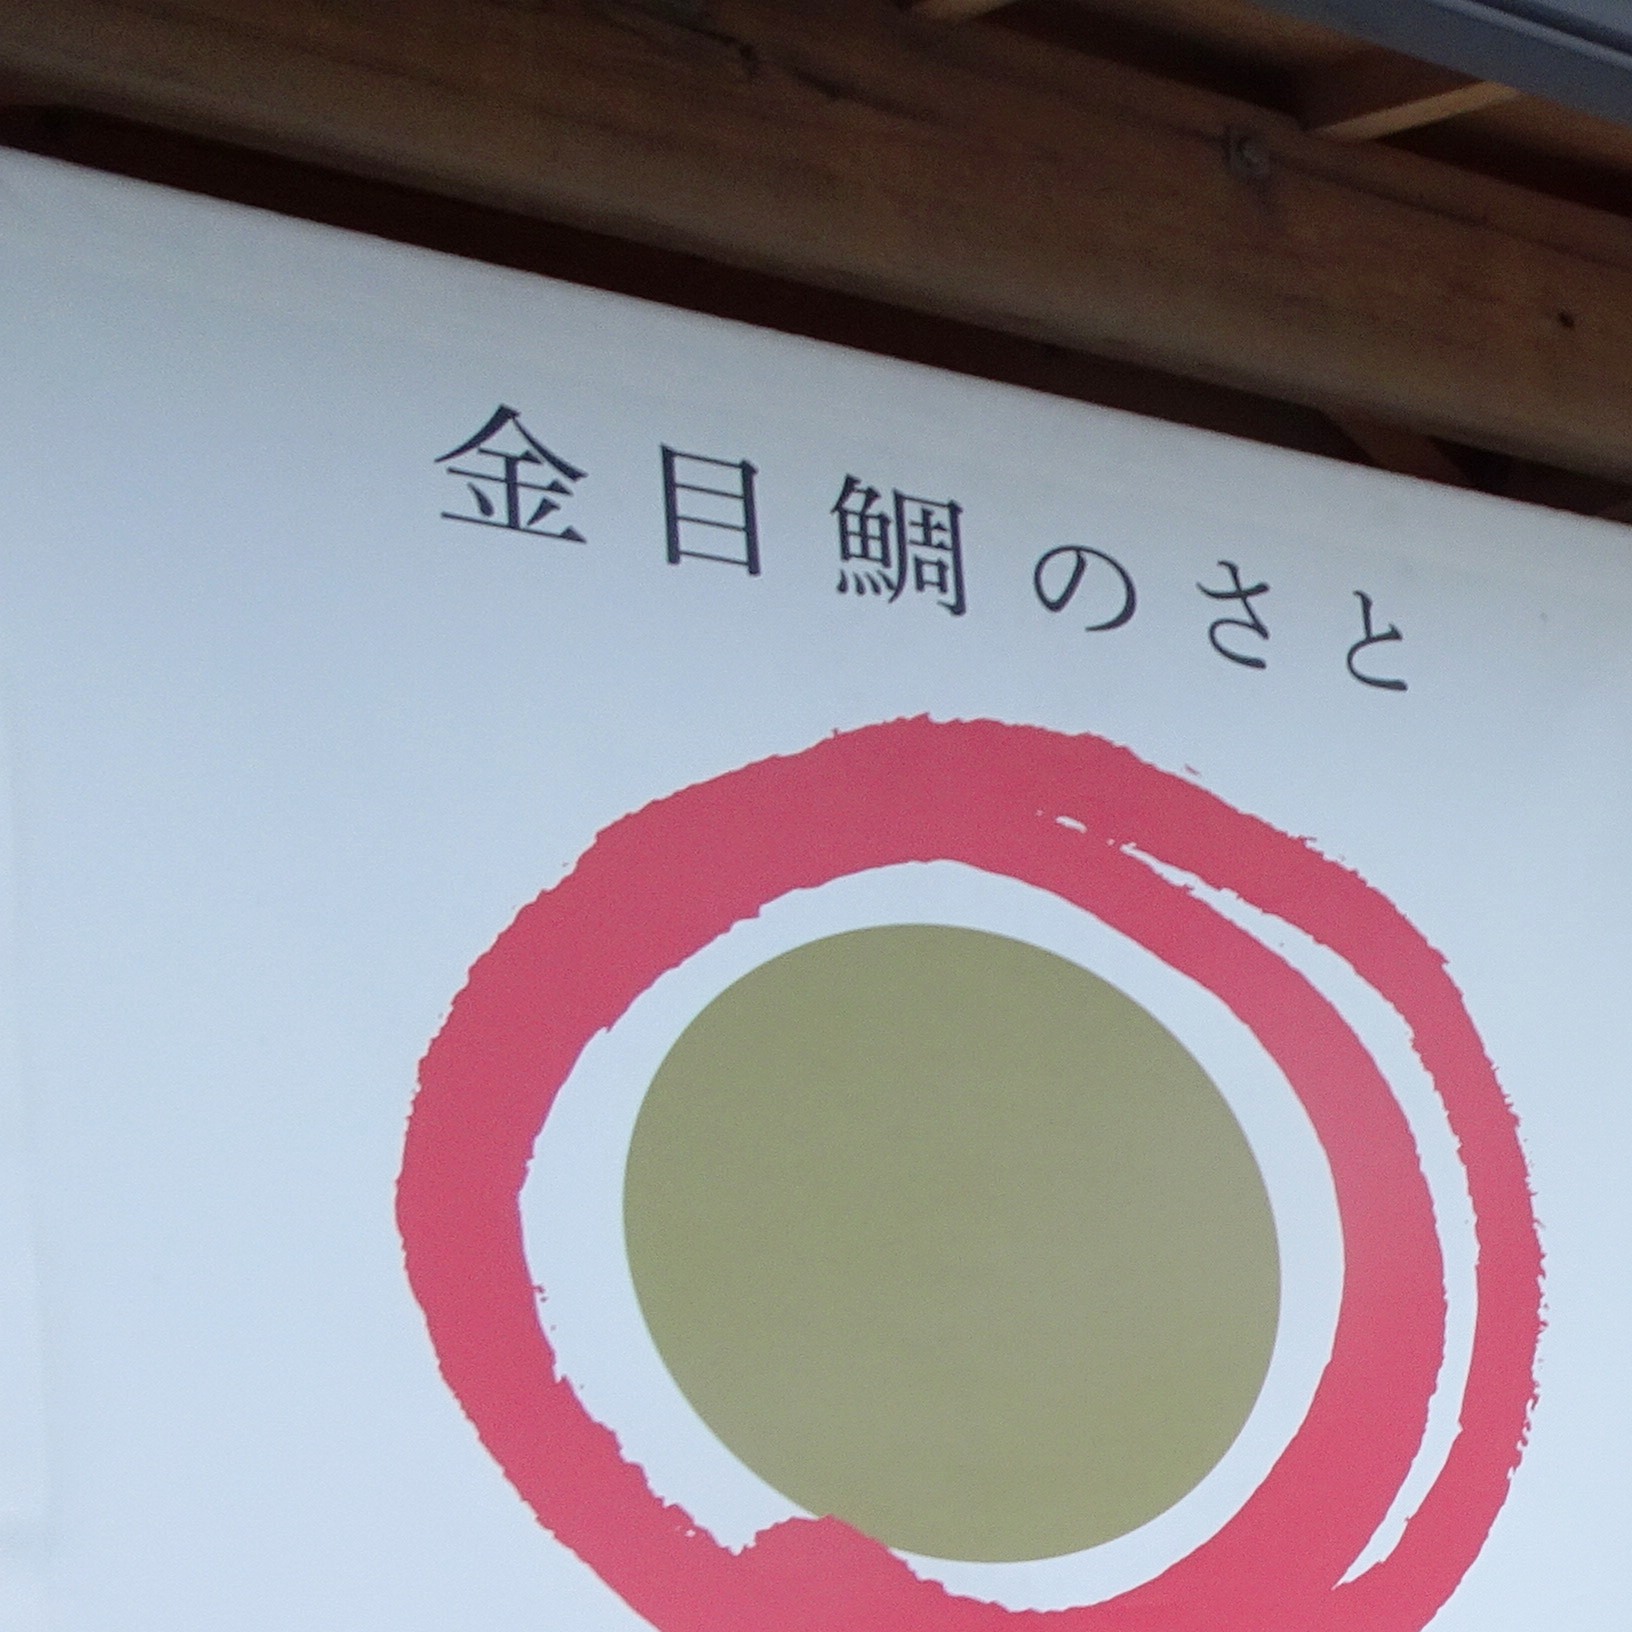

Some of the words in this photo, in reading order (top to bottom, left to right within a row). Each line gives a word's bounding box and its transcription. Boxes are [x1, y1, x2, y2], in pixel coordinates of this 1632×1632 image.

[434, 404, 1409, 692] 金目鯛のさと
